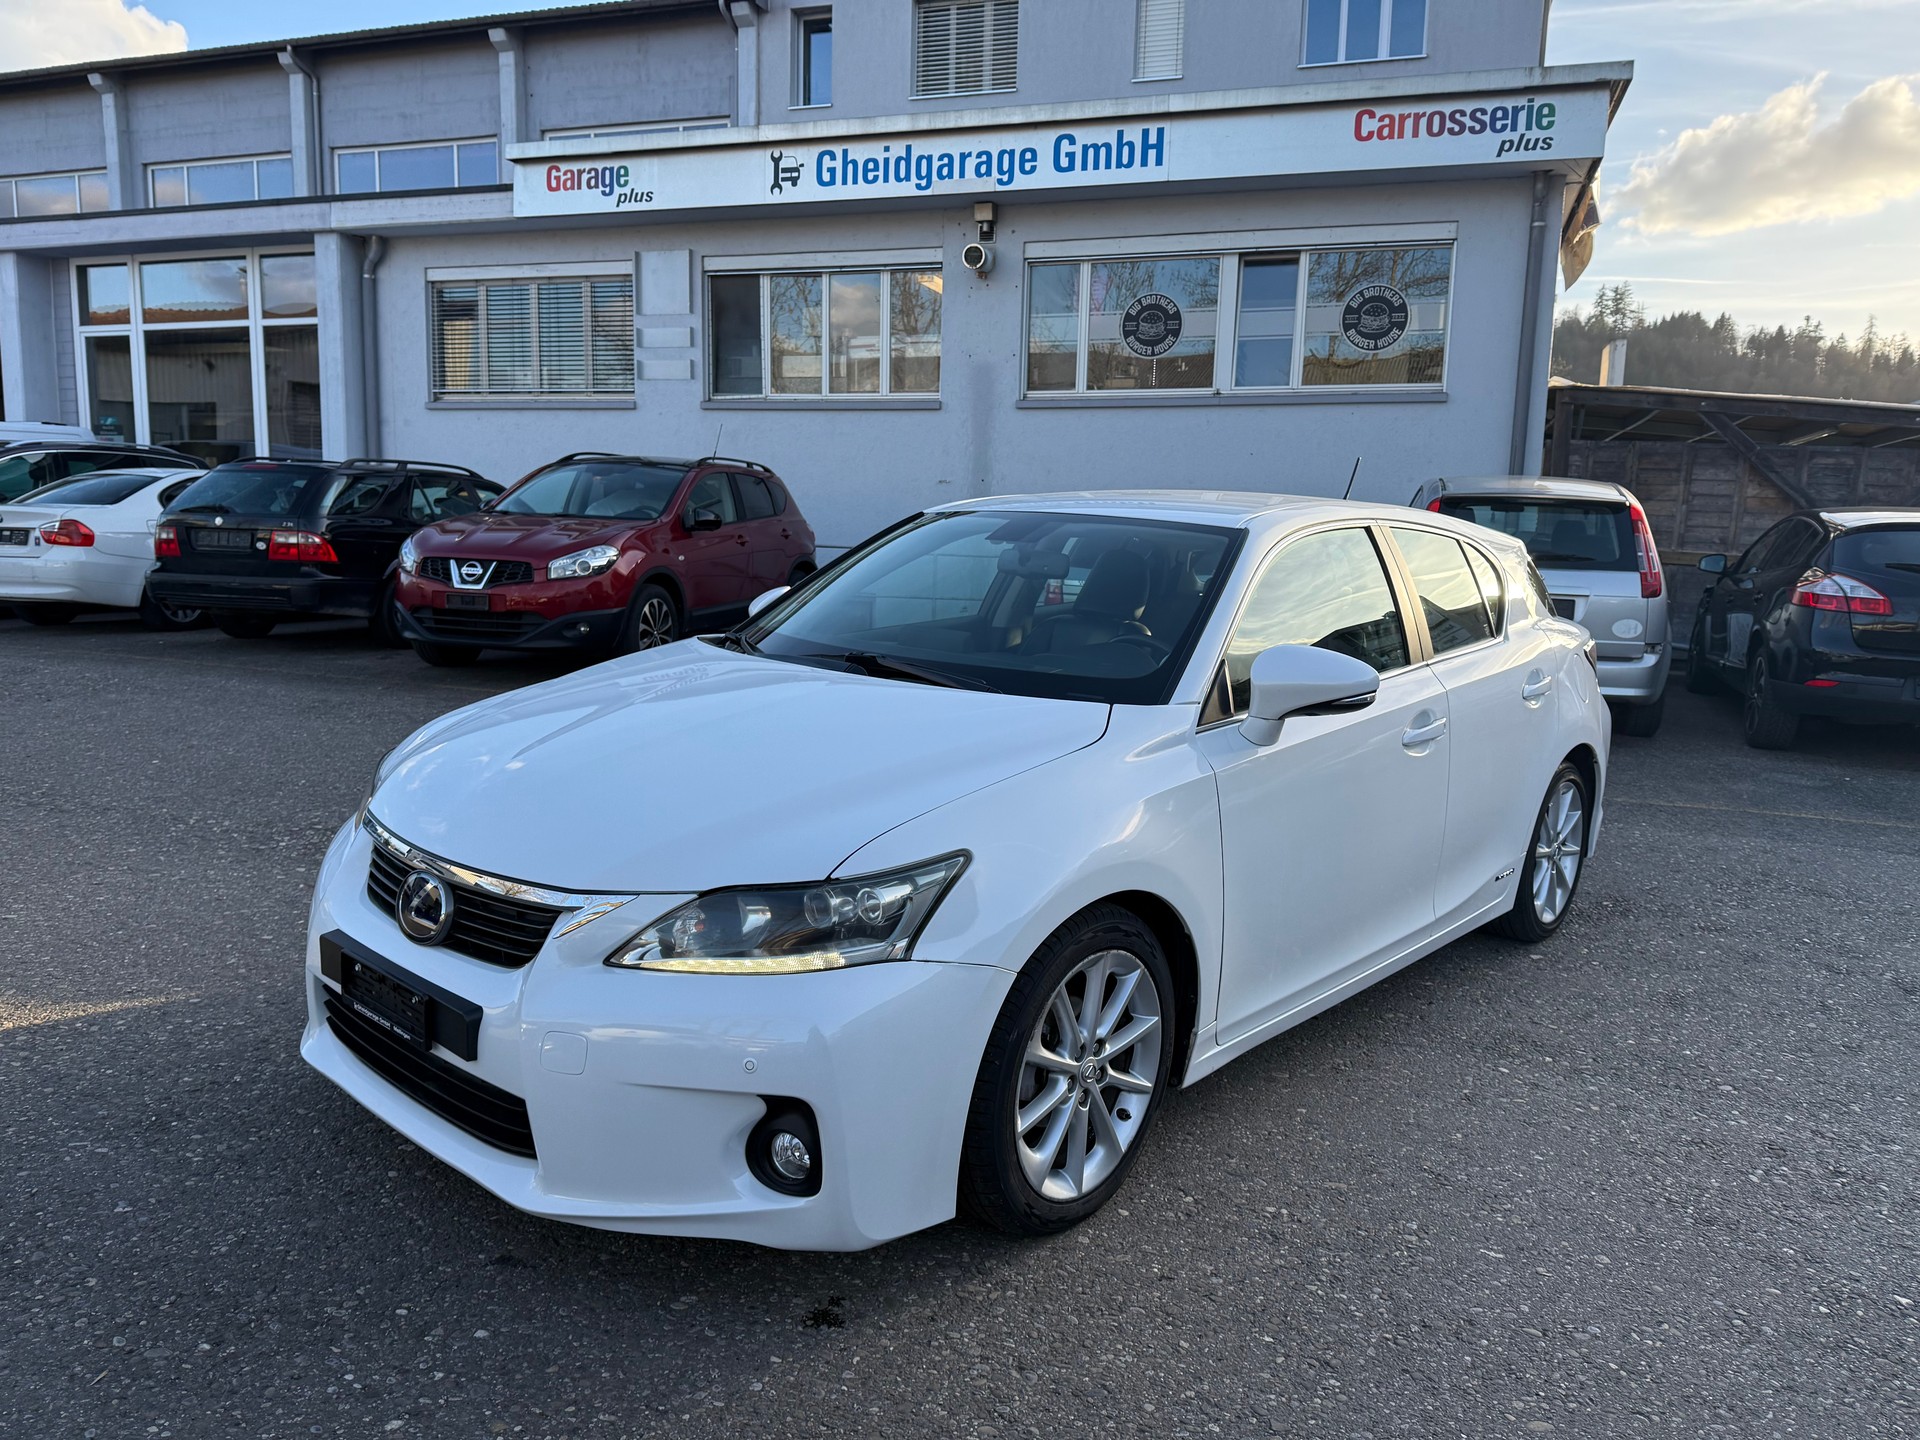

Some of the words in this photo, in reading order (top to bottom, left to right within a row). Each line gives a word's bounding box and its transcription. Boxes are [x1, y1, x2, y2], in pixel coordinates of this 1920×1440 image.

[1354, 98, 1557, 142] Carrosserie
[1496, 133, 1554, 157] plus
[816, 143, 1038, 191] Gheidgarage
[1053, 126, 1165, 173] GmbH
[546, 164, 629, 197] Garage
[616, 188, 654, 208] plus
[1128, 302, 1142, 316] BIG
[1140, 295, 1177, 315] BROTHERS
[1349, 293, 1364, 308] BIG
[1363, 286, 1403, 307] BROTHERS
[1126, 335, 1152, 355] BURGER
[1154, 334, 1177, 354] HOUSE
[1346, 328, 1375, 349] BURGER
[1377, 326, 1402, 348] HOUSE
